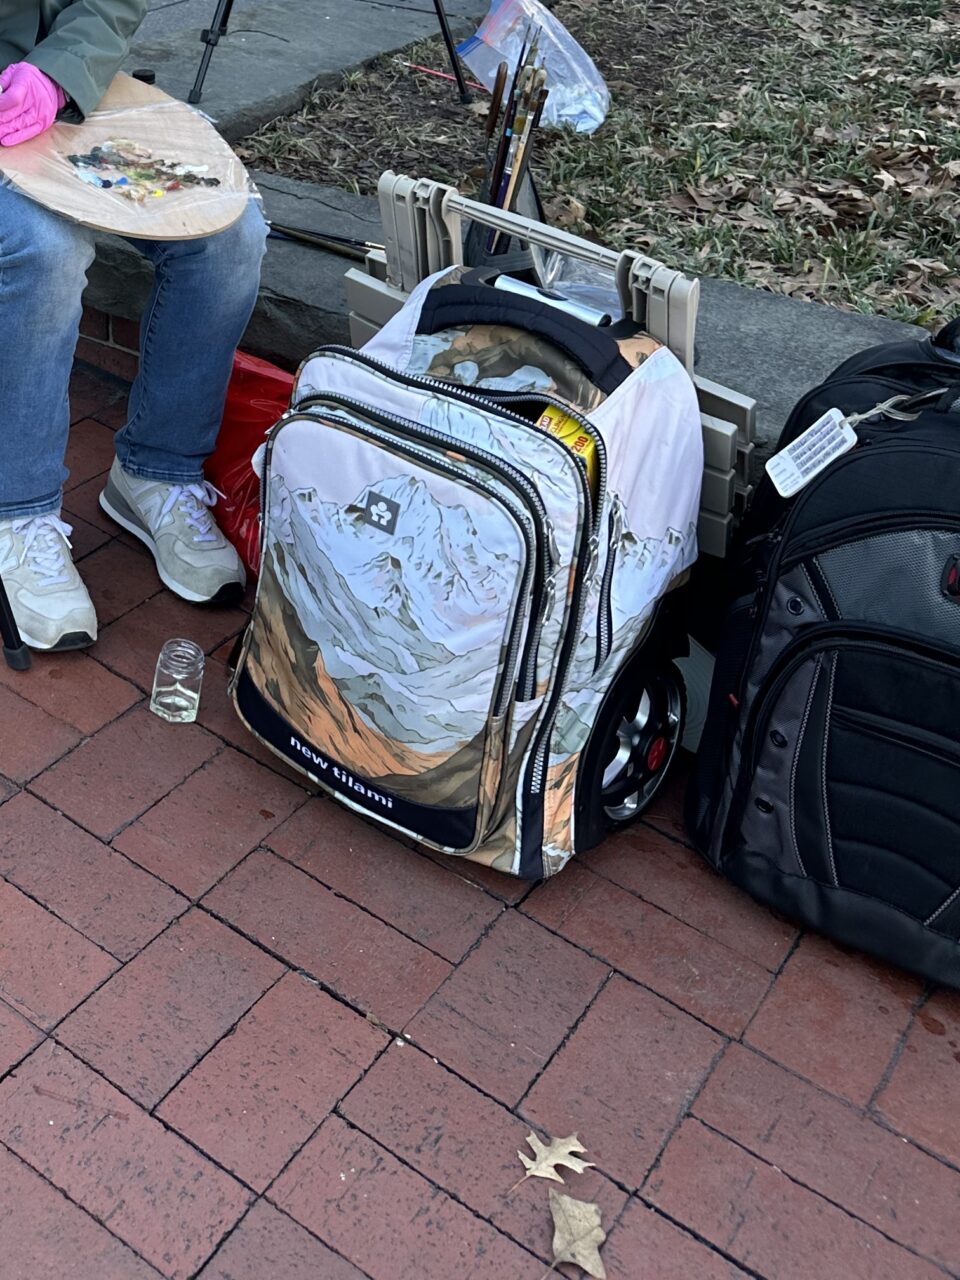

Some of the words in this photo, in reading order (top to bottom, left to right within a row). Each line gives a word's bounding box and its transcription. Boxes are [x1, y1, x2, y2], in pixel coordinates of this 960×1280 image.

[571, 435, 589, 453] 200
[290, 736, 329, 770] new
[332, 766, 393, 809] tilami
